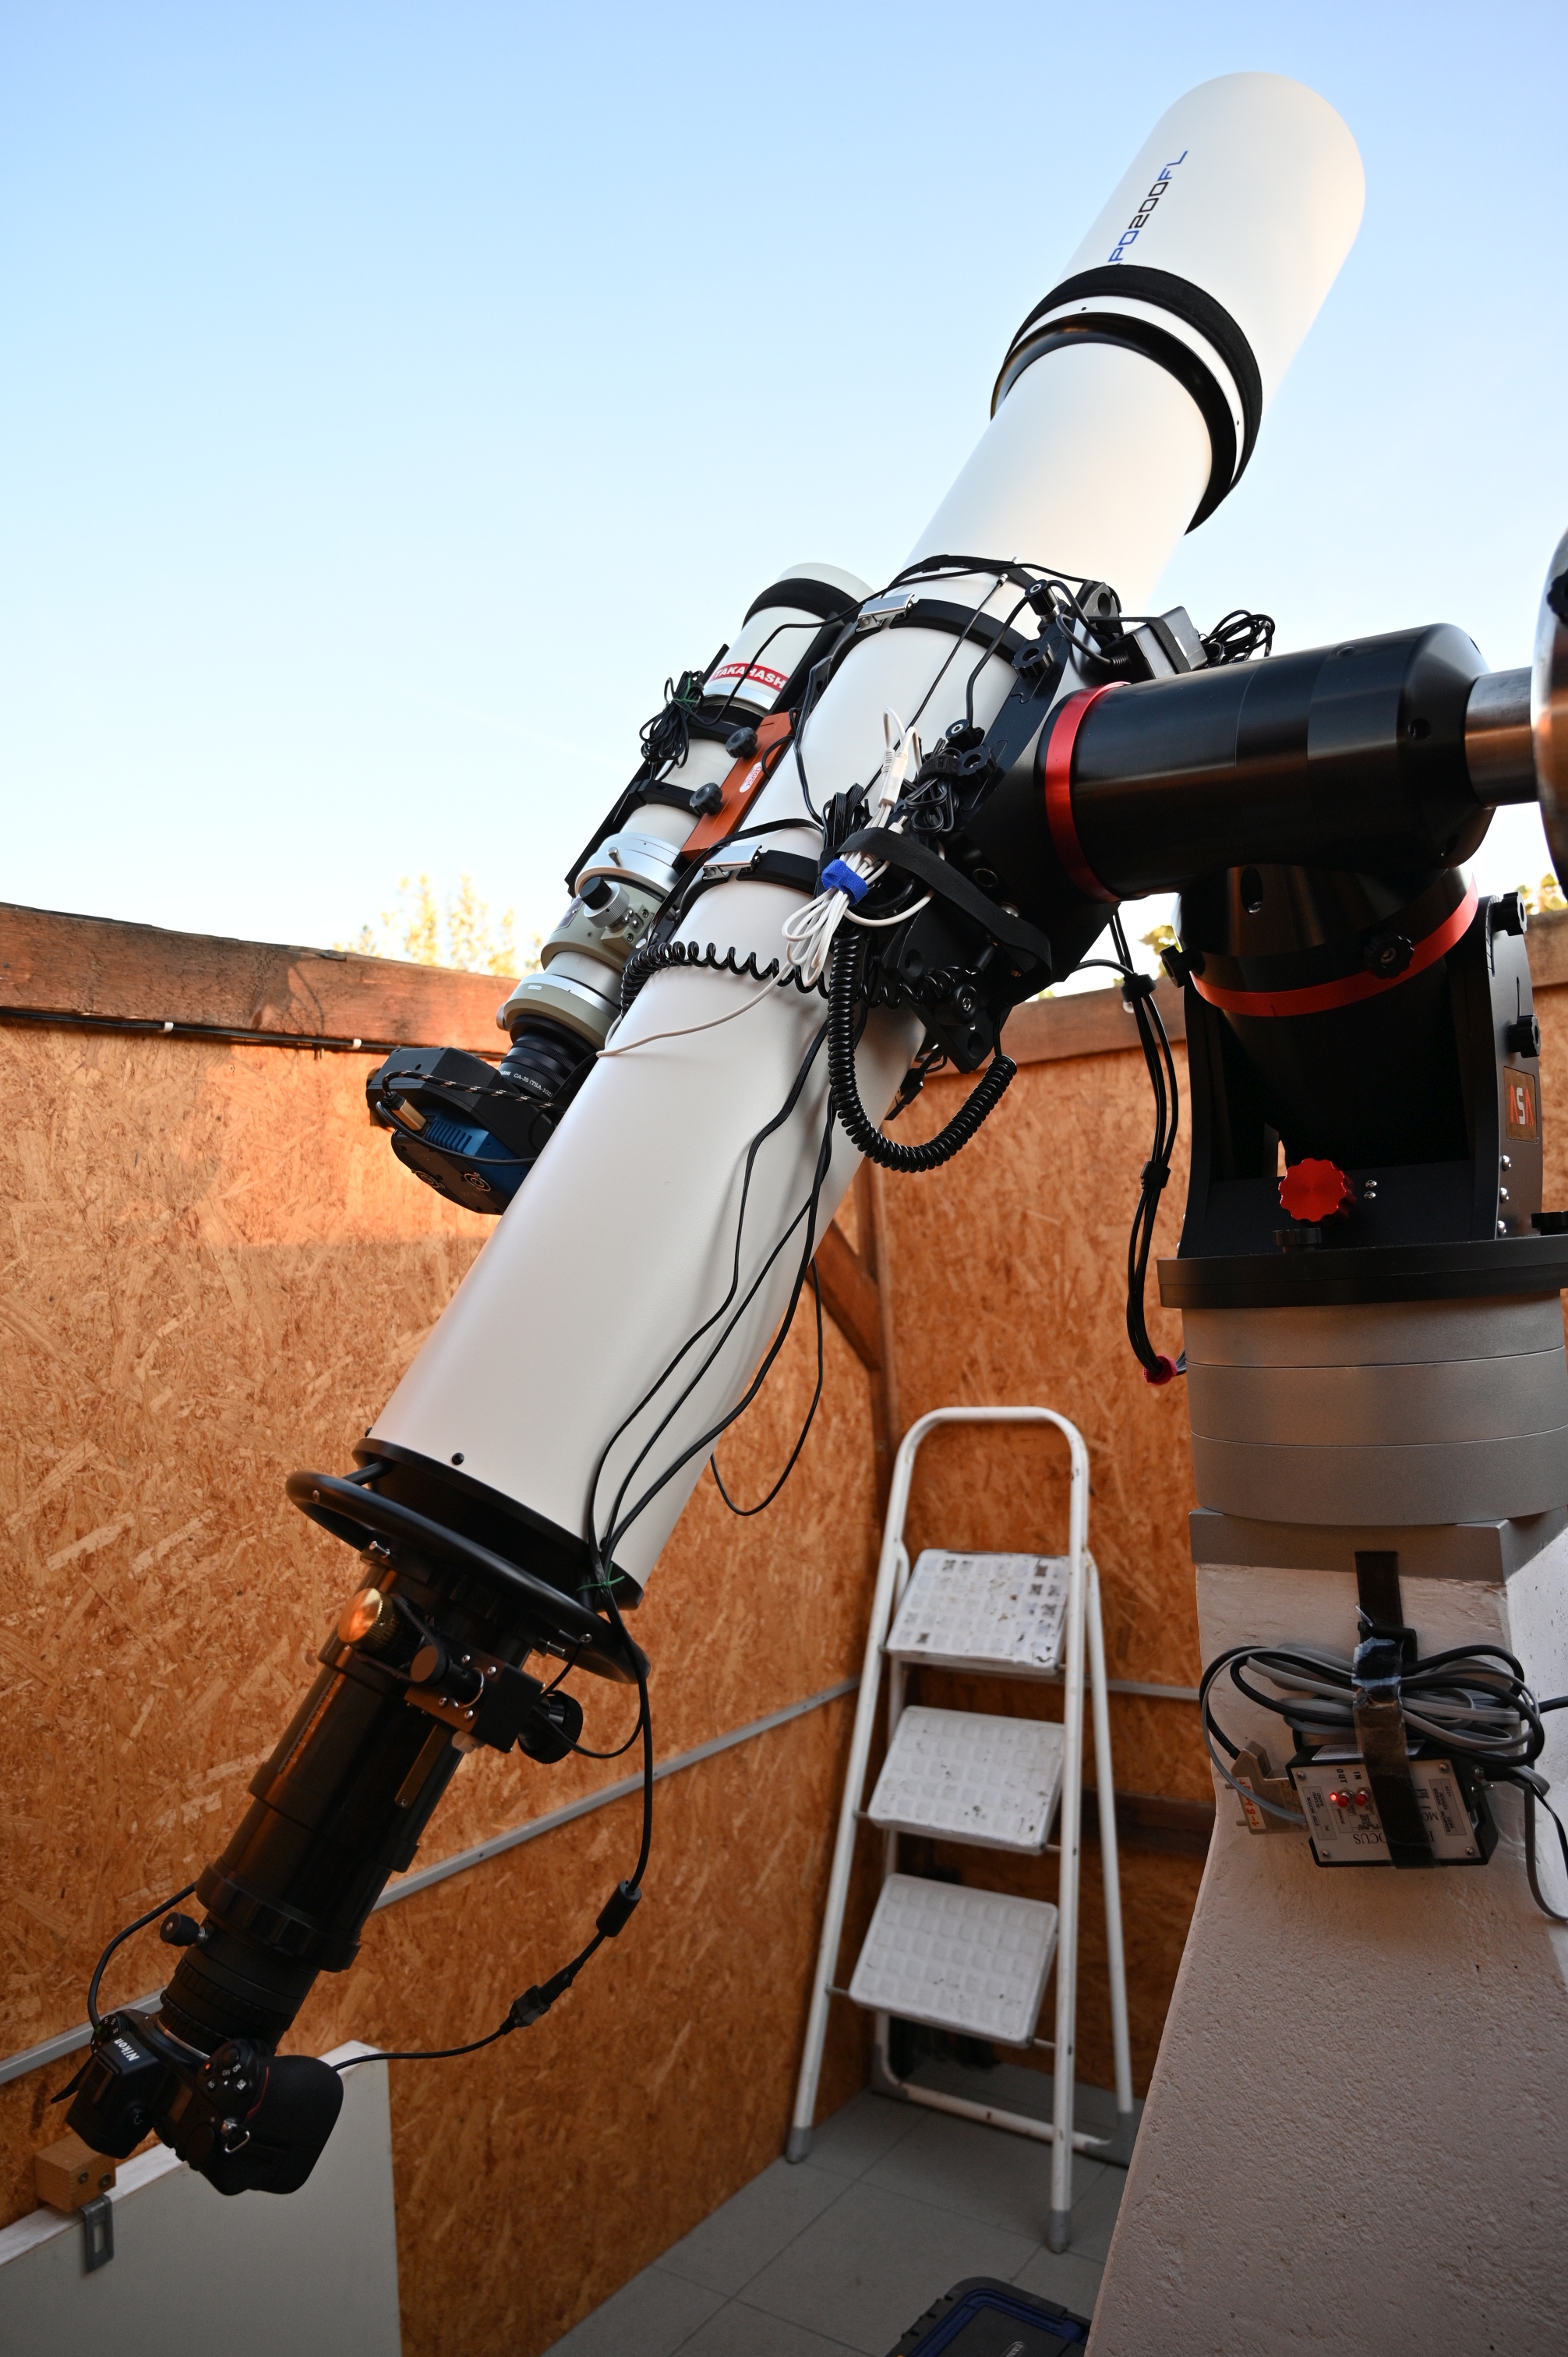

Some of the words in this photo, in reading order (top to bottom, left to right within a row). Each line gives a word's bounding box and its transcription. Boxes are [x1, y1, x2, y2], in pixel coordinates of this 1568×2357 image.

[1107, 150, 1188, 263] PO200FL
[715, 666, 787, 689] TAKAHASH
[514, 1073, 530, 1083] CA-35
[530, 1080, 553, 1097] (TSA-102)
[1337, 1769, 1347, 1783] OUT
[1353, 1771, 1362, 1780] IN
[114, 2038, 140, 2062] Nikon
